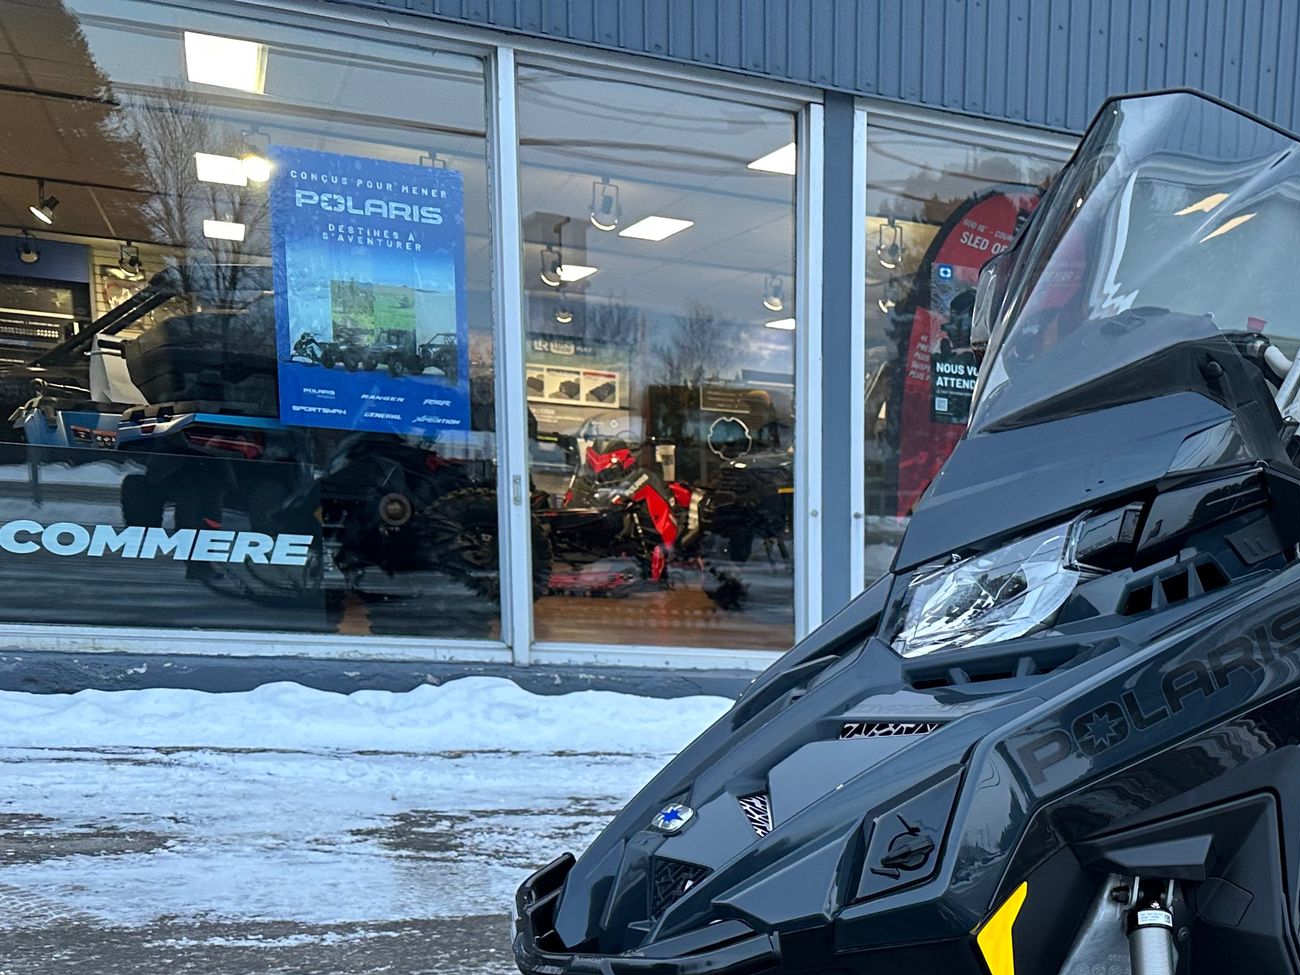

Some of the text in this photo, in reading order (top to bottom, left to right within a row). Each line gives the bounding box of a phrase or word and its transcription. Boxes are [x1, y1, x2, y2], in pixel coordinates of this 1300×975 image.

[290, 170, 448, 199] CONÇUS POUR MENER
[295, 189, 443, 225] POLARIS
[322, 231, 422, 252] S'AVENTURER
[960, 231, 989, 250] SLED
[936, 362, 965, 376] NOUS
[360, 393, 405, 403] RANGER
[0, 520, 314, 566] COMMERE
